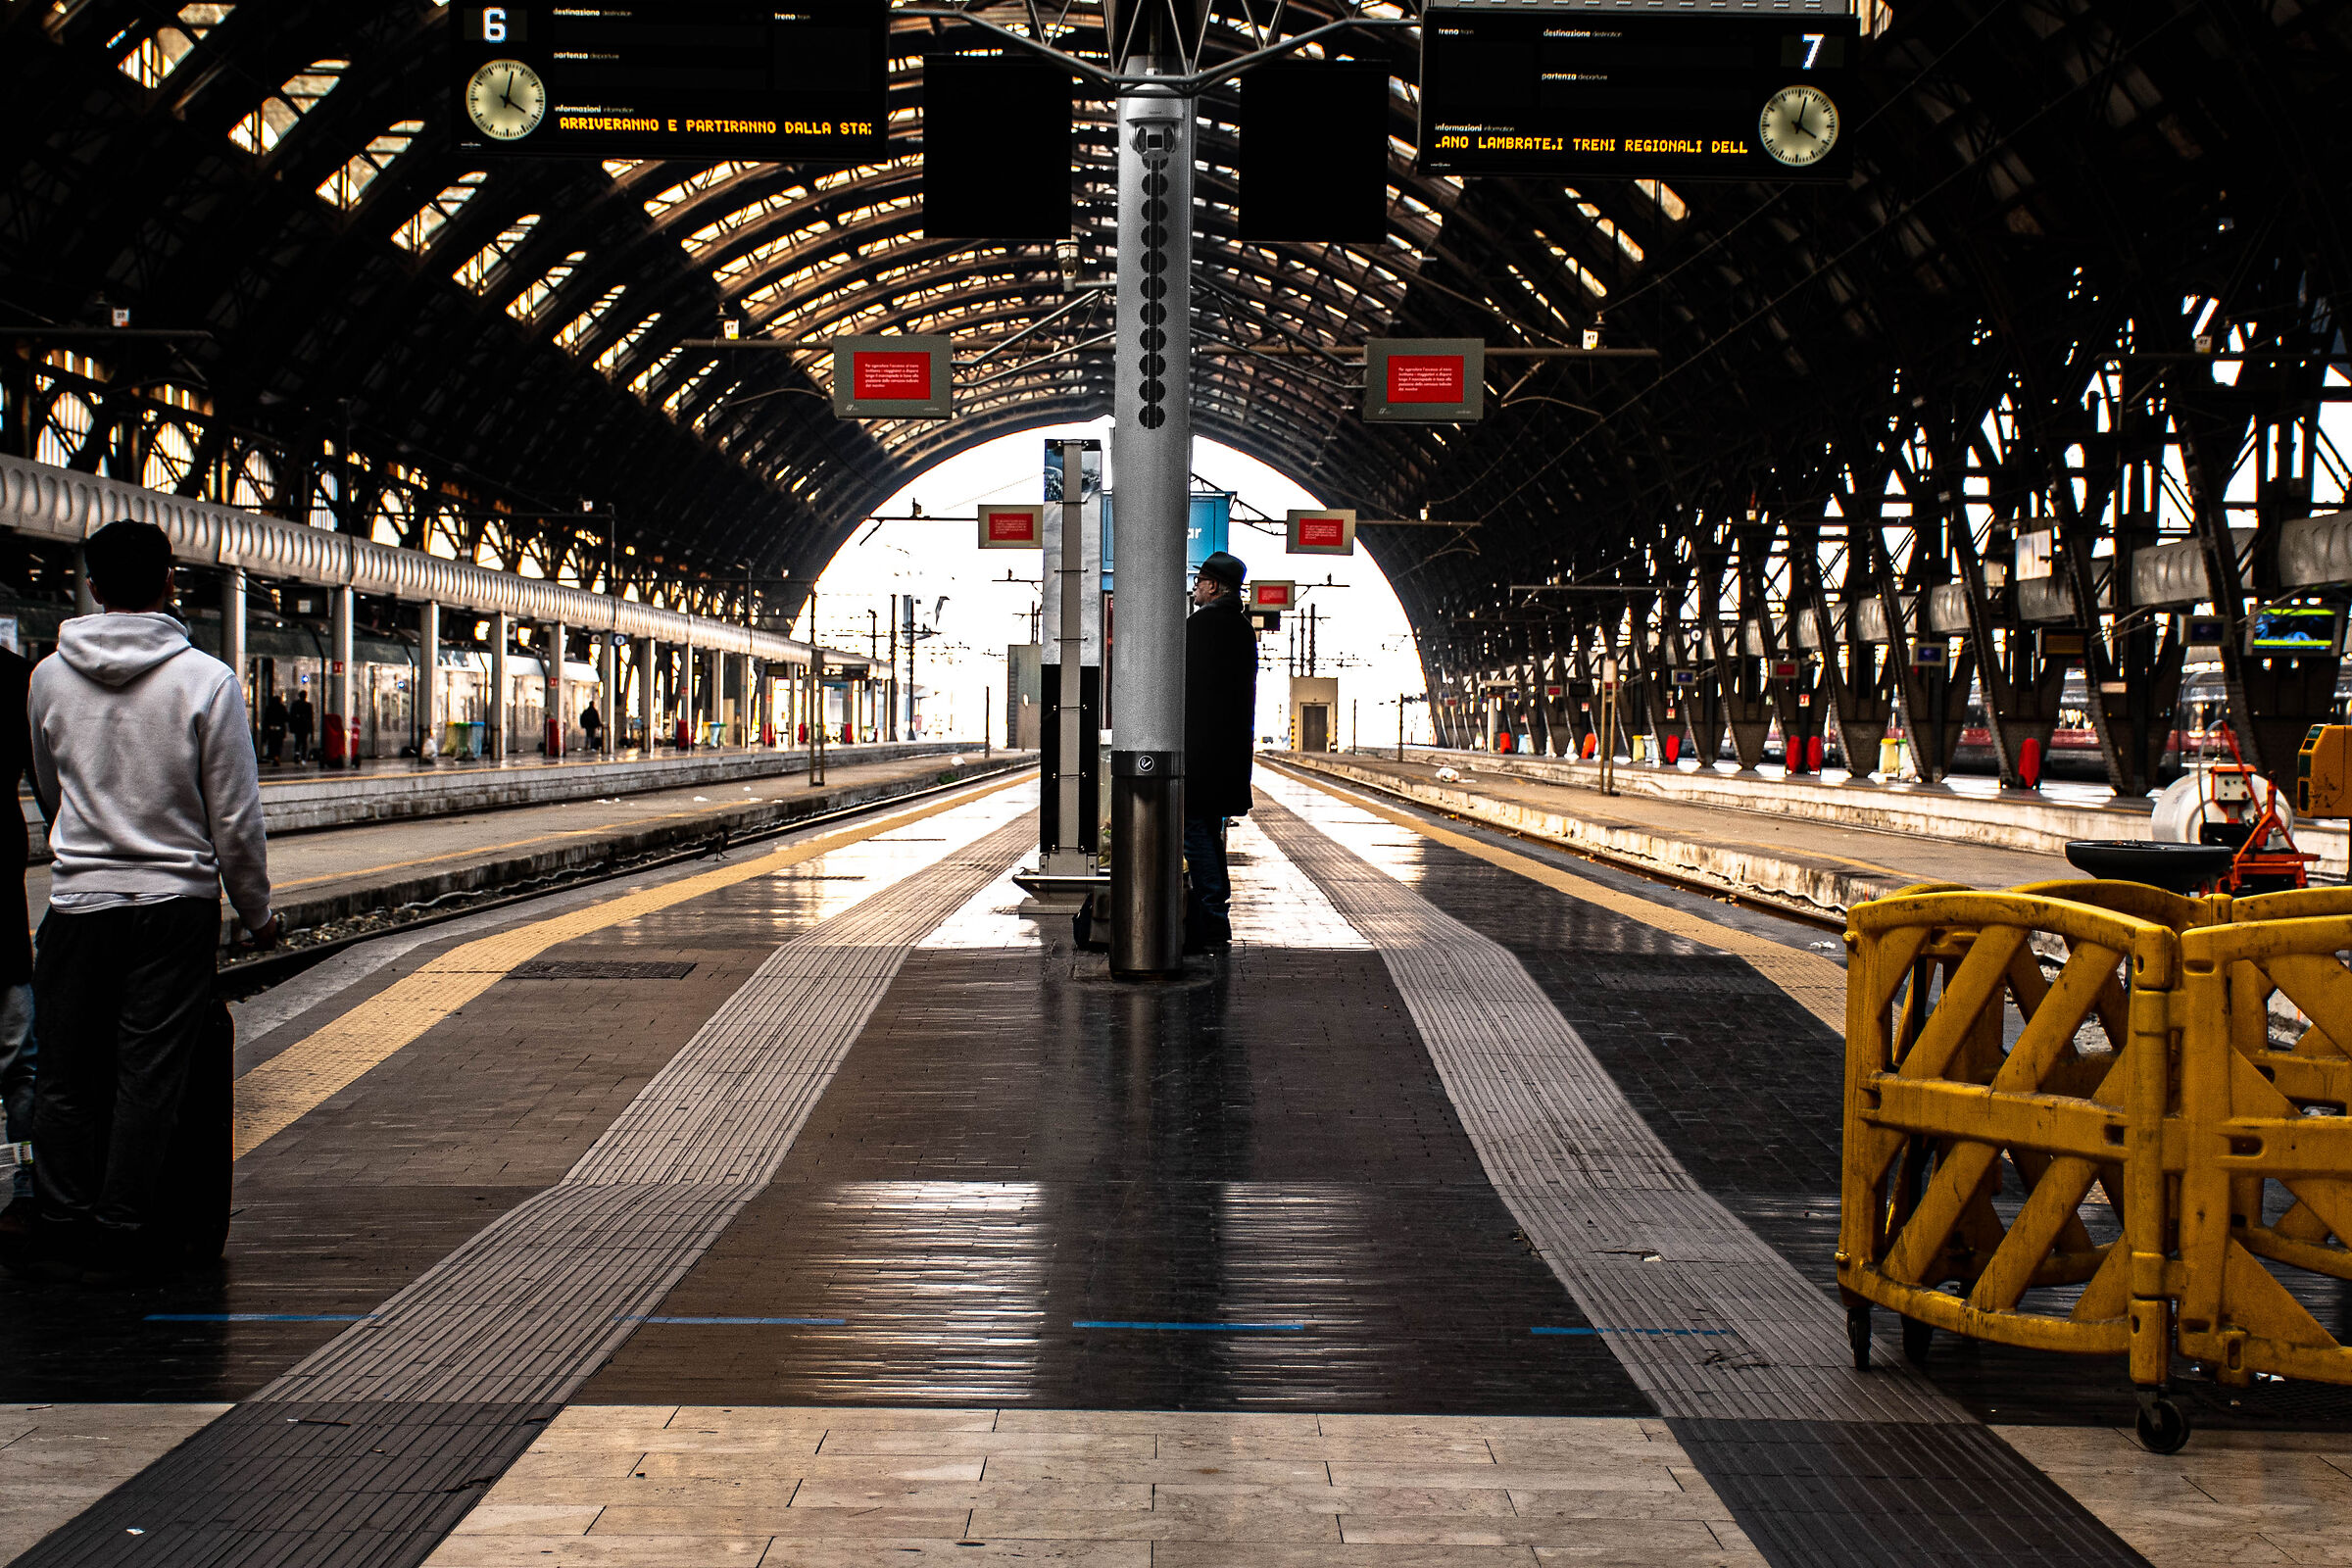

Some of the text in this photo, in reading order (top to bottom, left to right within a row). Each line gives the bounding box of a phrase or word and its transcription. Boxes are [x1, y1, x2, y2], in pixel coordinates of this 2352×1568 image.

[553, 7, 601, 17] destinazione
[774, 12, 796, 21] treno
[482, 7, 507, 43] 6
[1438, 27, 1459, 36] treno
[1543, 27, 1591, 38] destinazione
[553, 52, 589, 61] partenza
[1801, 33, 1826, 71] 7
[1542, 72, 1578, 81] partenza
[554, 103, 602, 114] informazioni
[560, 117, 660, 132] ARRIVERANNO
[667, 119, 678, 132] E
[686, 119, 777, 134] PARTIRANNO
[785, 122, 832, 135] DALLA
[1434, 122, 1483, 132] informazioni
[1573, 137, 1616, 152] TRENI
[1624, 139, 1703, 154] REGIONALI
[1711, 140, 1748, 154] DELL
